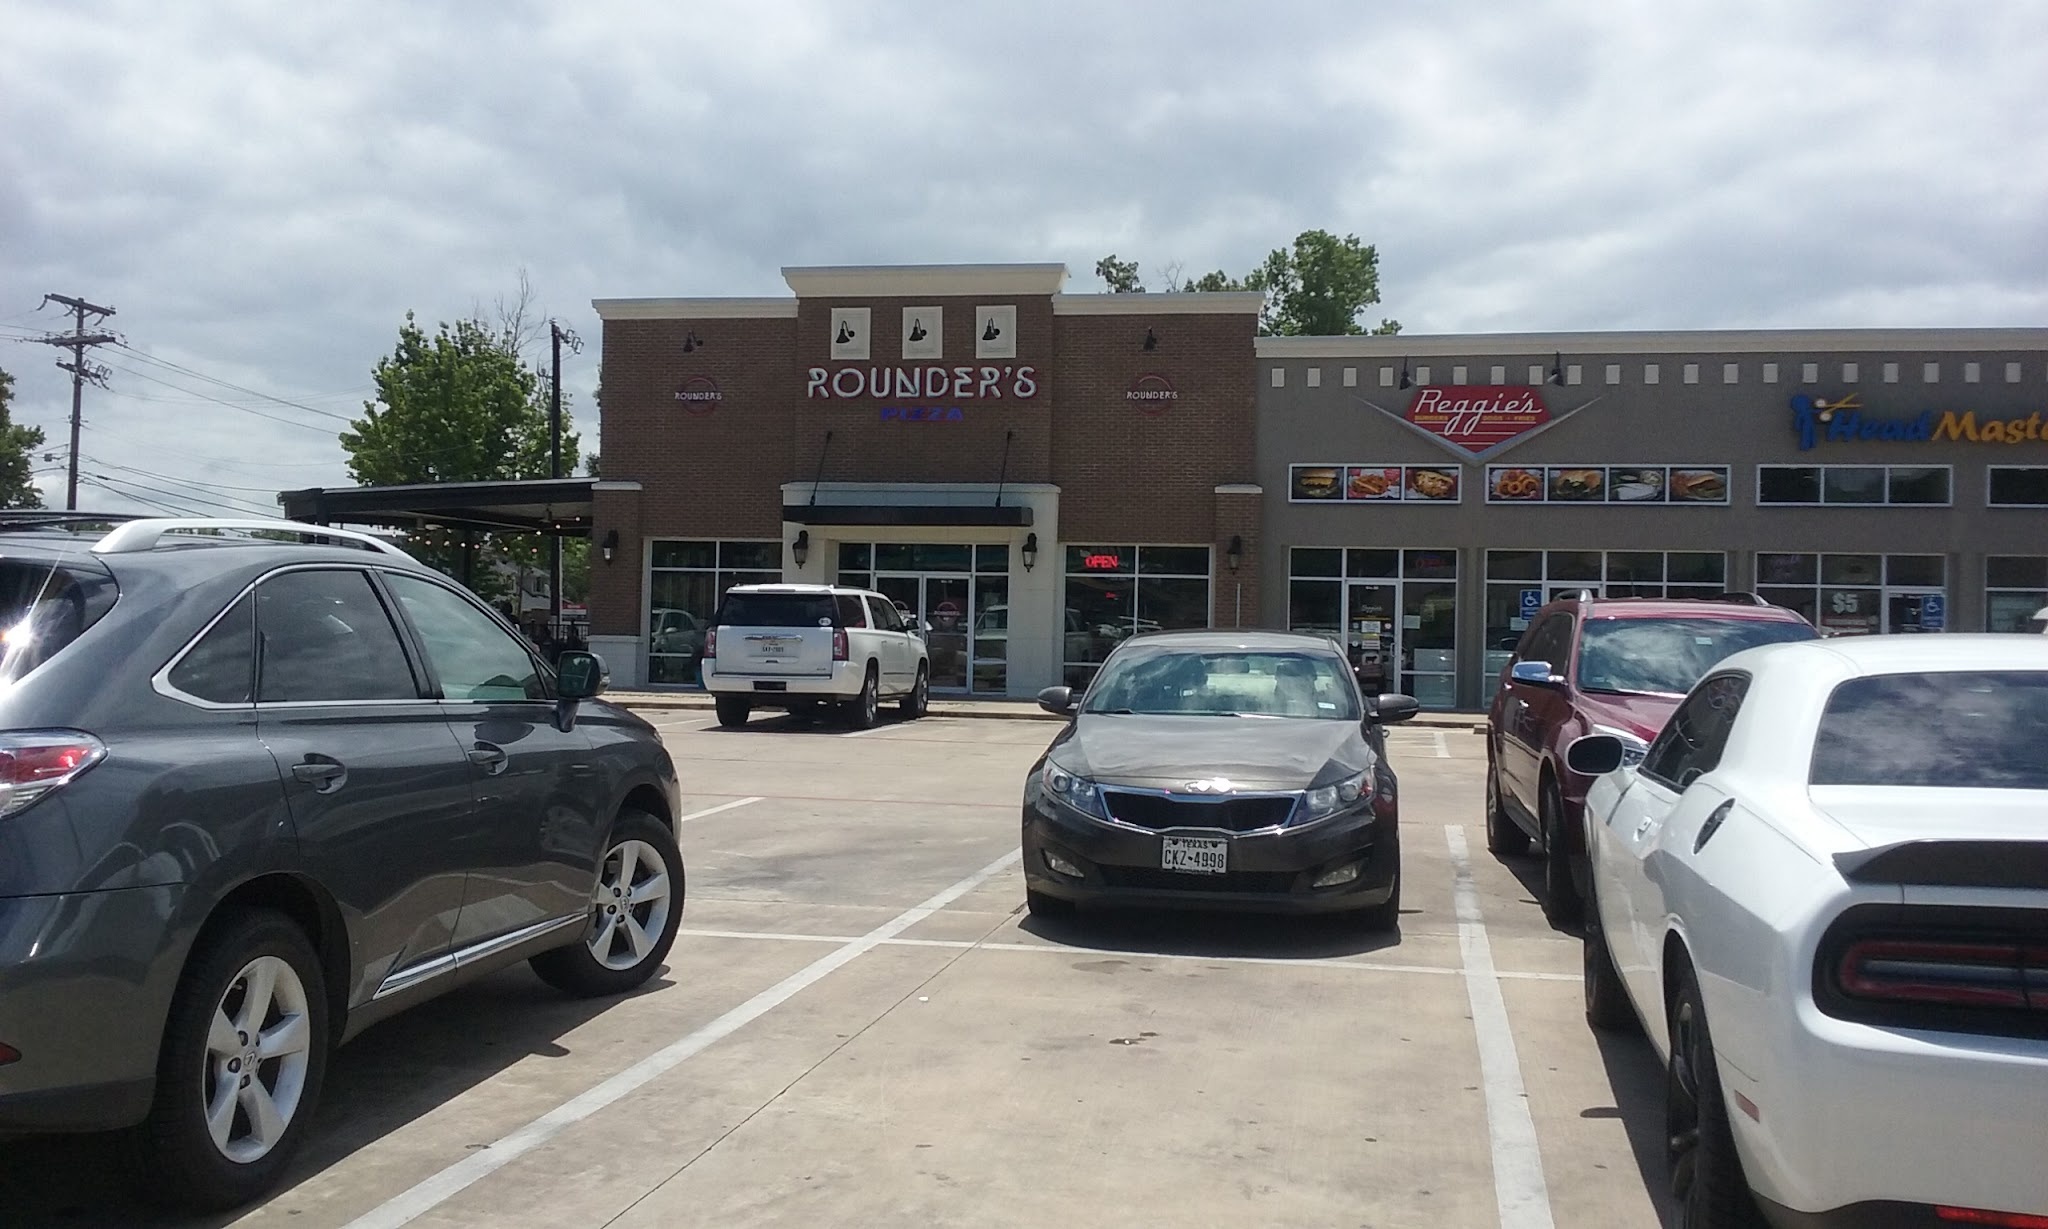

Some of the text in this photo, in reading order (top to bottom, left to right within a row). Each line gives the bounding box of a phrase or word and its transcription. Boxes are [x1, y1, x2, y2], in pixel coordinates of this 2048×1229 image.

[808, 367, 1037, 398] ROUNDER'S
[674, 392, 722, 400] ROUNDER'S
[1126, 390, 1178, 400] ROUNDER'S
[880, 406, 965, 421] PIZZA
[1414, 389, 1543, 436] Reggie's
[1827, 410, 1932, 443] Head
[1085, 555, 1118, 568] OPEN
[1832, 592, 1858, 614] $5
[1182, 839, 1208, 849] TEXAS
